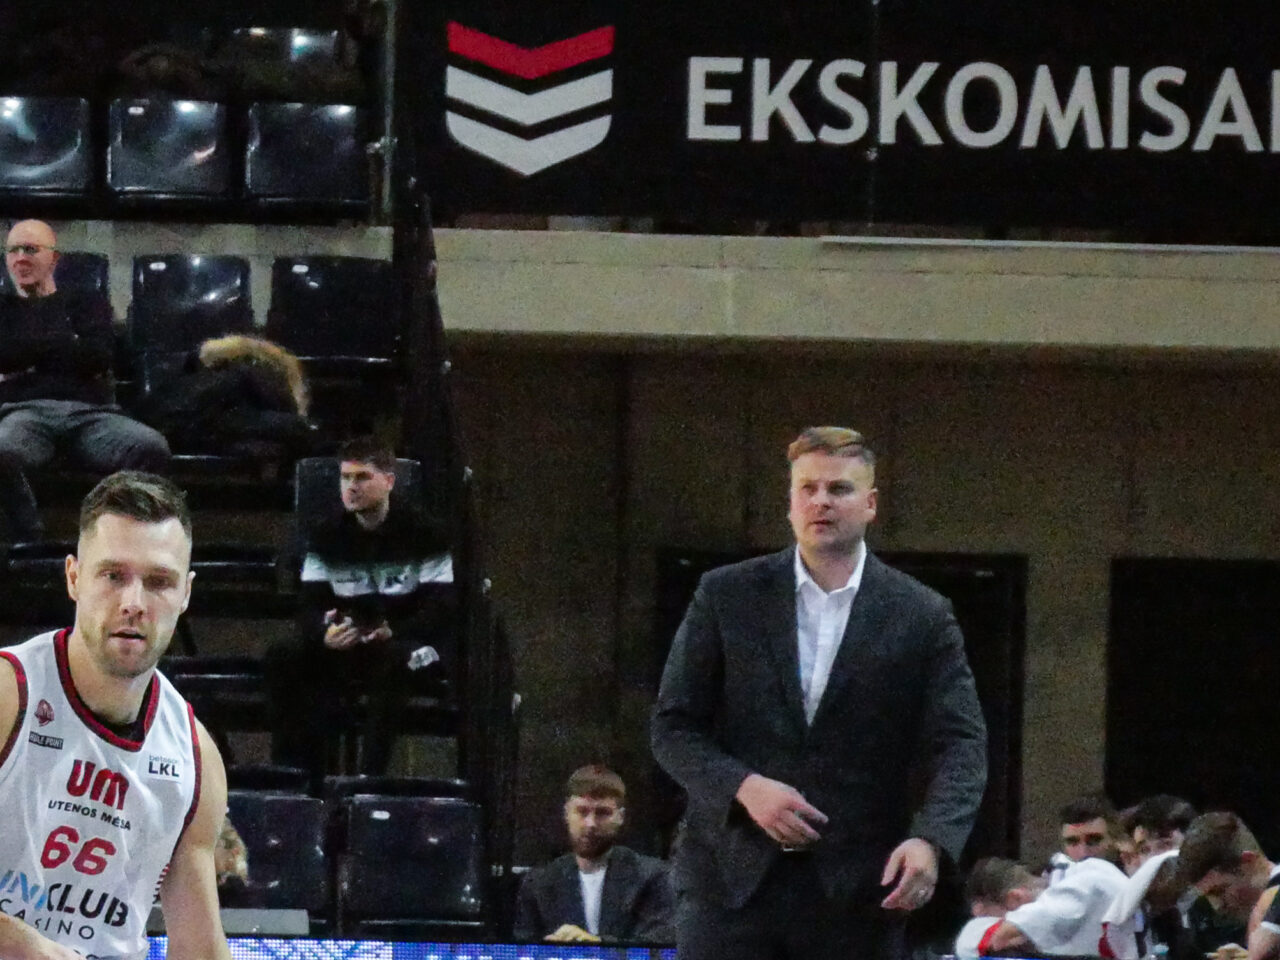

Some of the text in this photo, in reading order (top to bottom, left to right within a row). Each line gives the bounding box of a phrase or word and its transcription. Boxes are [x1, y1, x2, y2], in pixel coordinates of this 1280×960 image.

[685, 56, 1280, 154] EKSKOMISA
[148, 761, 181, 777] LKL
[48, 799, 98, 819] UTENOS
[39, 825, 117, 876] 66
